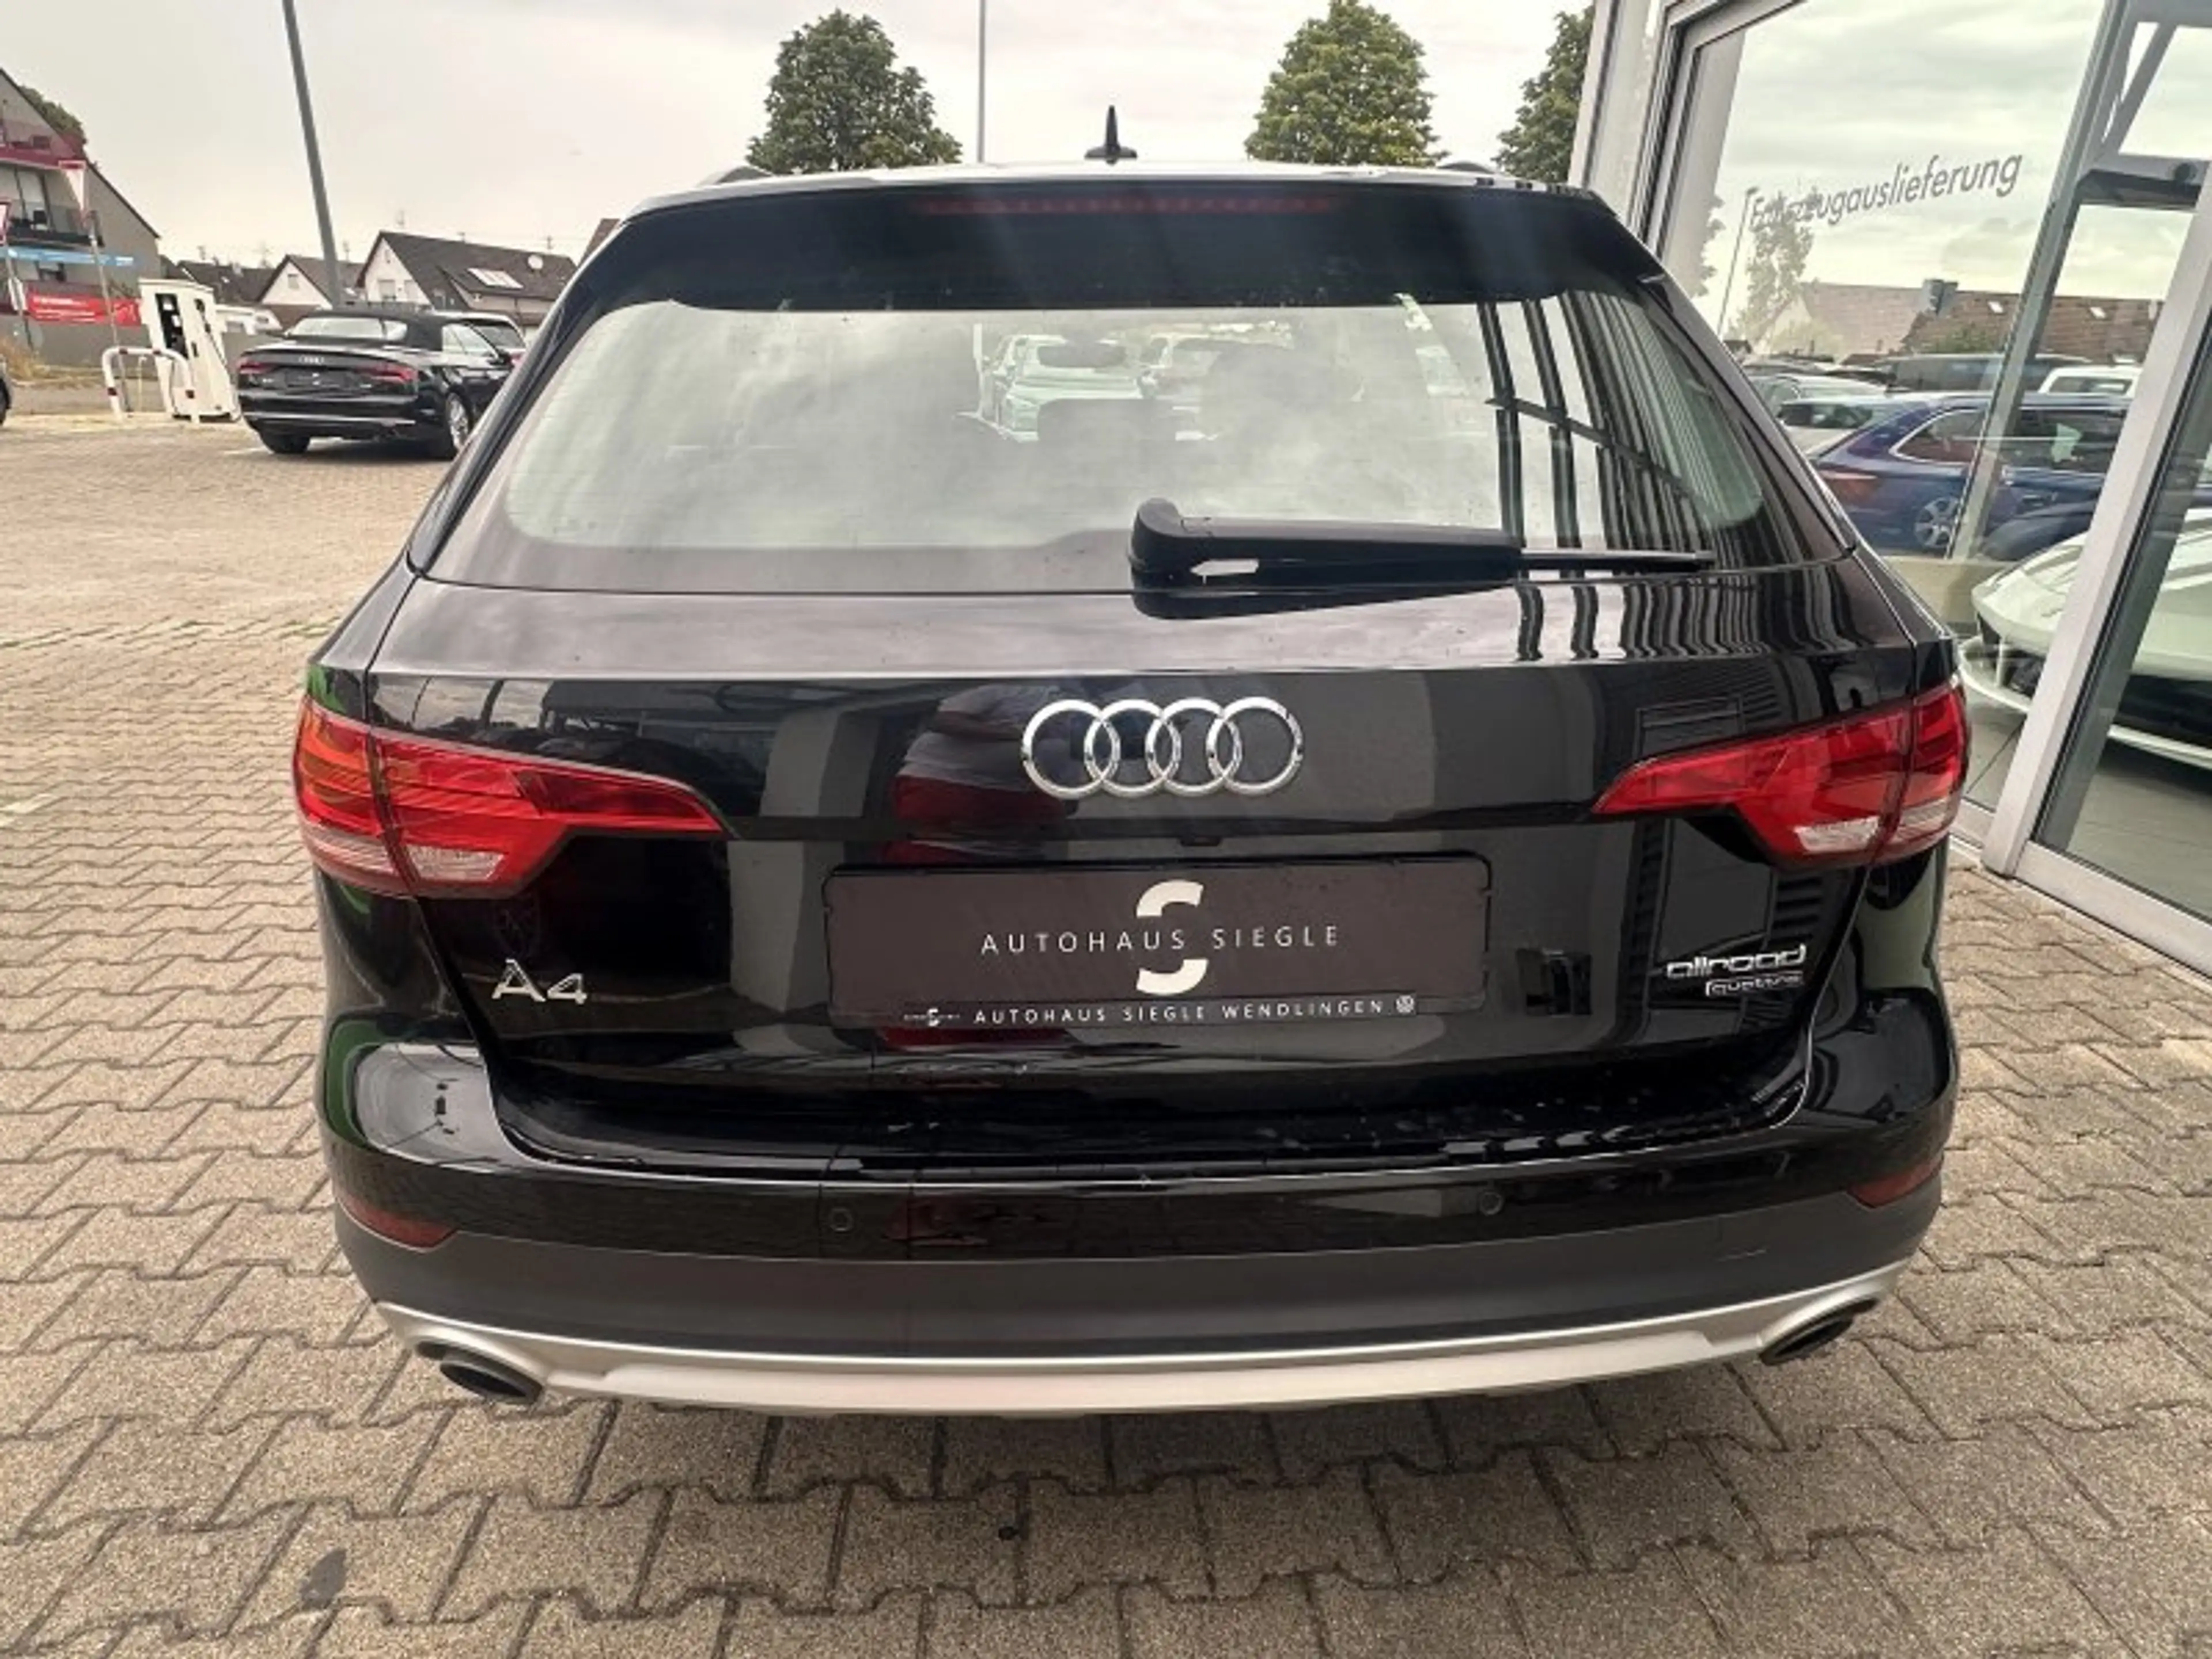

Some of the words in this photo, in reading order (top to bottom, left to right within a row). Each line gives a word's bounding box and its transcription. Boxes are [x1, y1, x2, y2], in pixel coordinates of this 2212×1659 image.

[1749, 154, 2023, 225] Fhzugauslieferung
[981, 929, 1184, 954] AUTOHAUS
[1212, 926, 1338, 949] SIEGLE
[1666, 942, 1806, 978] allroad
[491, 957, 588, 1005] A4
[974, 1007, 1106, 1024] AUTOHAUS
[1123, 1006, 1206, 1022] SIEGLE
[1222, 999, 1383, 1019] WENDLINGEN
